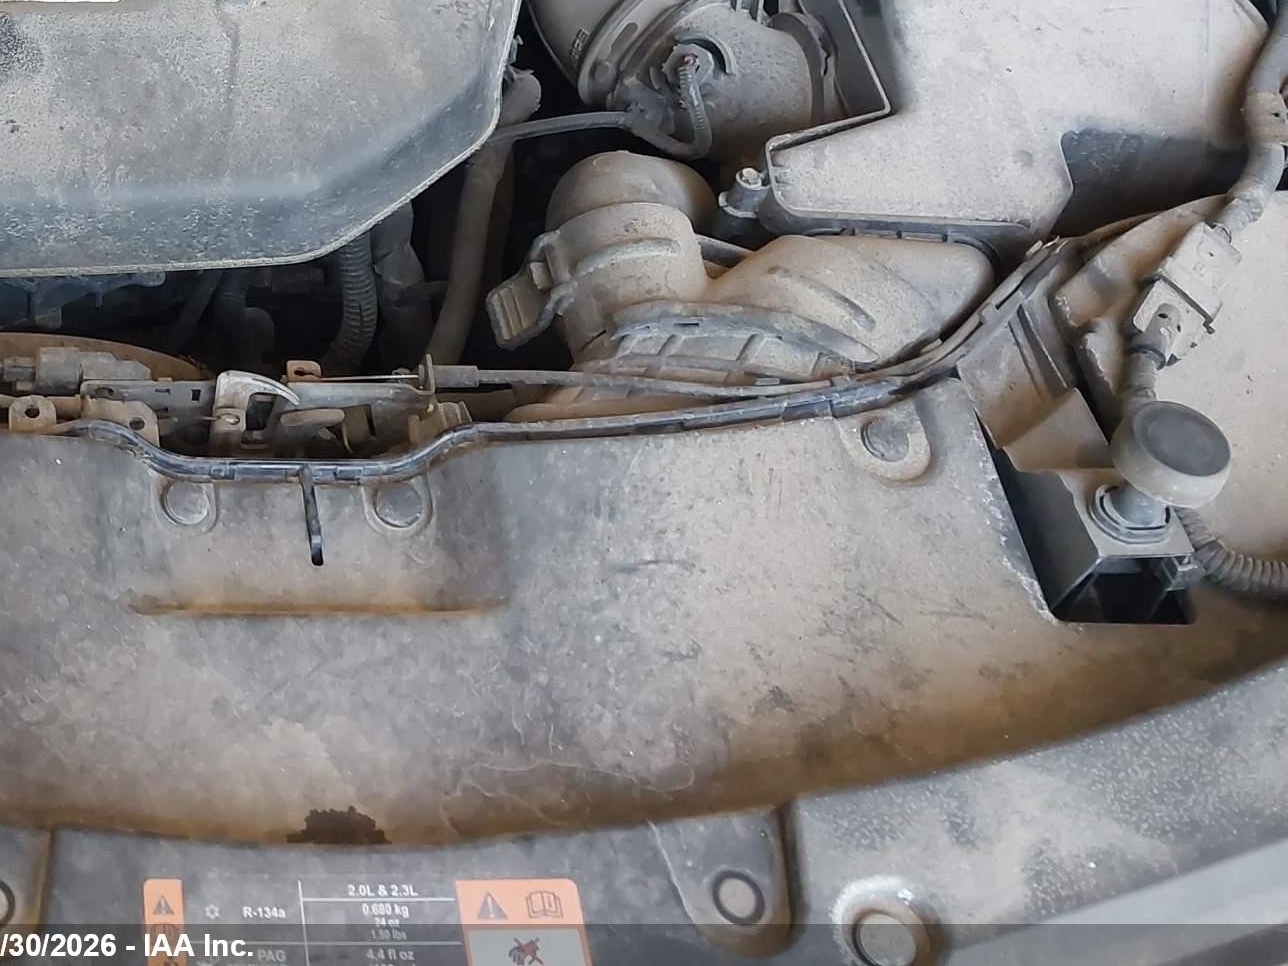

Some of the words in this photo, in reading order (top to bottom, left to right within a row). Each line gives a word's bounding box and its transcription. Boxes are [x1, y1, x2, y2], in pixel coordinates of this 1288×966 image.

[347, 884, 375, 896] 2.0L
[377, 884, 388, 897] &
[390, 884, 419, 897] 2.3L
[242, 906, 287, 919] R-134a
[394, 903, 409, 918] kg
[392, 929, 408, 940] lbs
[257, 949, 287, 962] PAG
[367, 948, 386, 960] 4.4
[399, 950, 416, 961] oz
